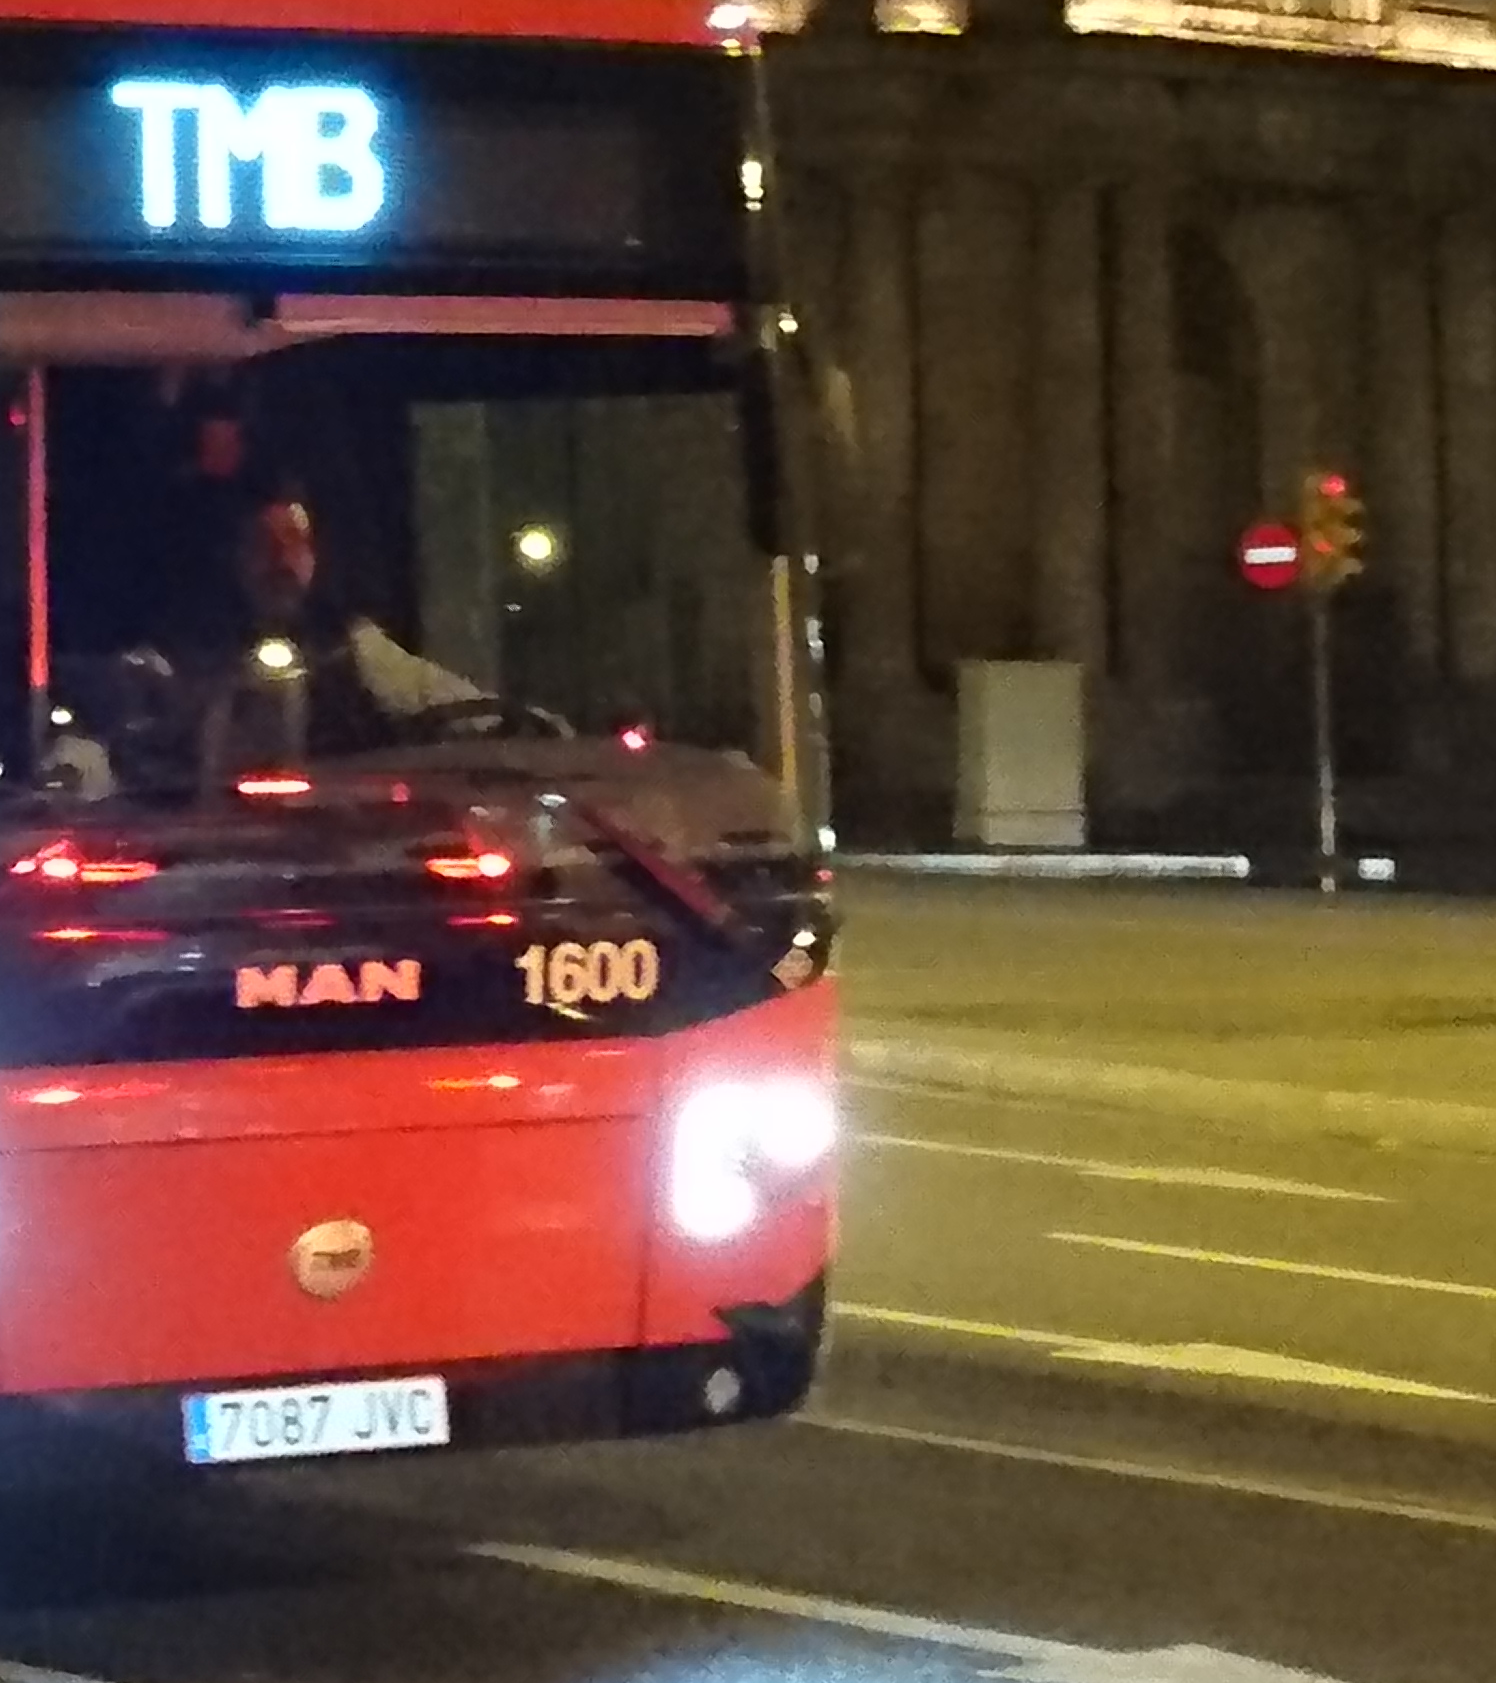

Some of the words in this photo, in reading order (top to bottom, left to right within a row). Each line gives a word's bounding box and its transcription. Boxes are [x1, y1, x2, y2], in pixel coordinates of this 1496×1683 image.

[112, 79, 385, 231] TMB
[236, 959, 422, 1007] MAN
[514, 938, 660, 1005] 1600
[220, 1394, 331, 1453] 7087
[353, 1388, 431, 1440] JVC
